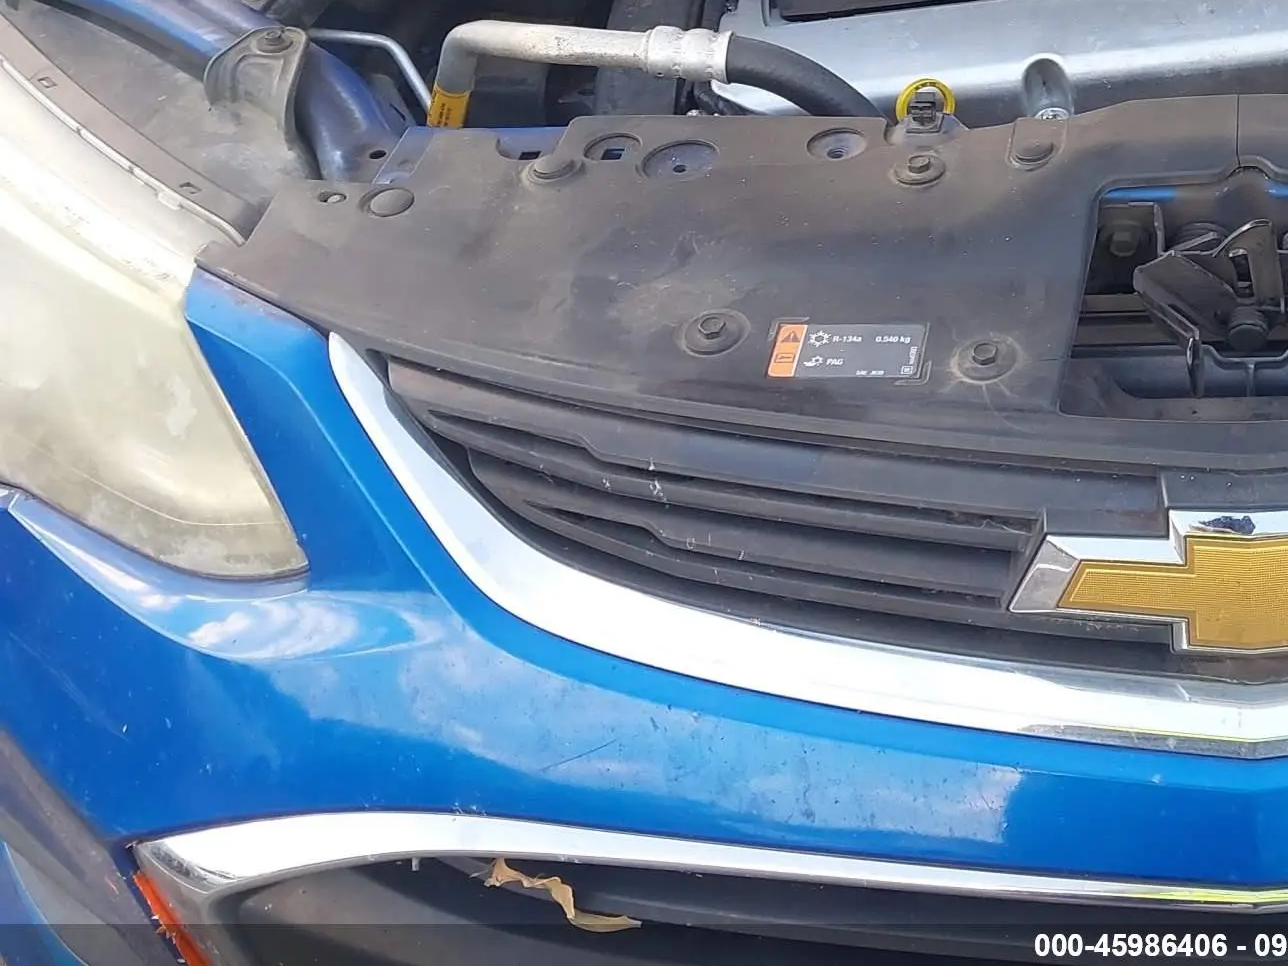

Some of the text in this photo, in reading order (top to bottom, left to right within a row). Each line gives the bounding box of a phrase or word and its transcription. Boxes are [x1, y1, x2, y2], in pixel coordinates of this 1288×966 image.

[832, 335, 862, 343] R-134a
[899, 335, 911, 344] kg
[826, 358, 844, 366] PAG
